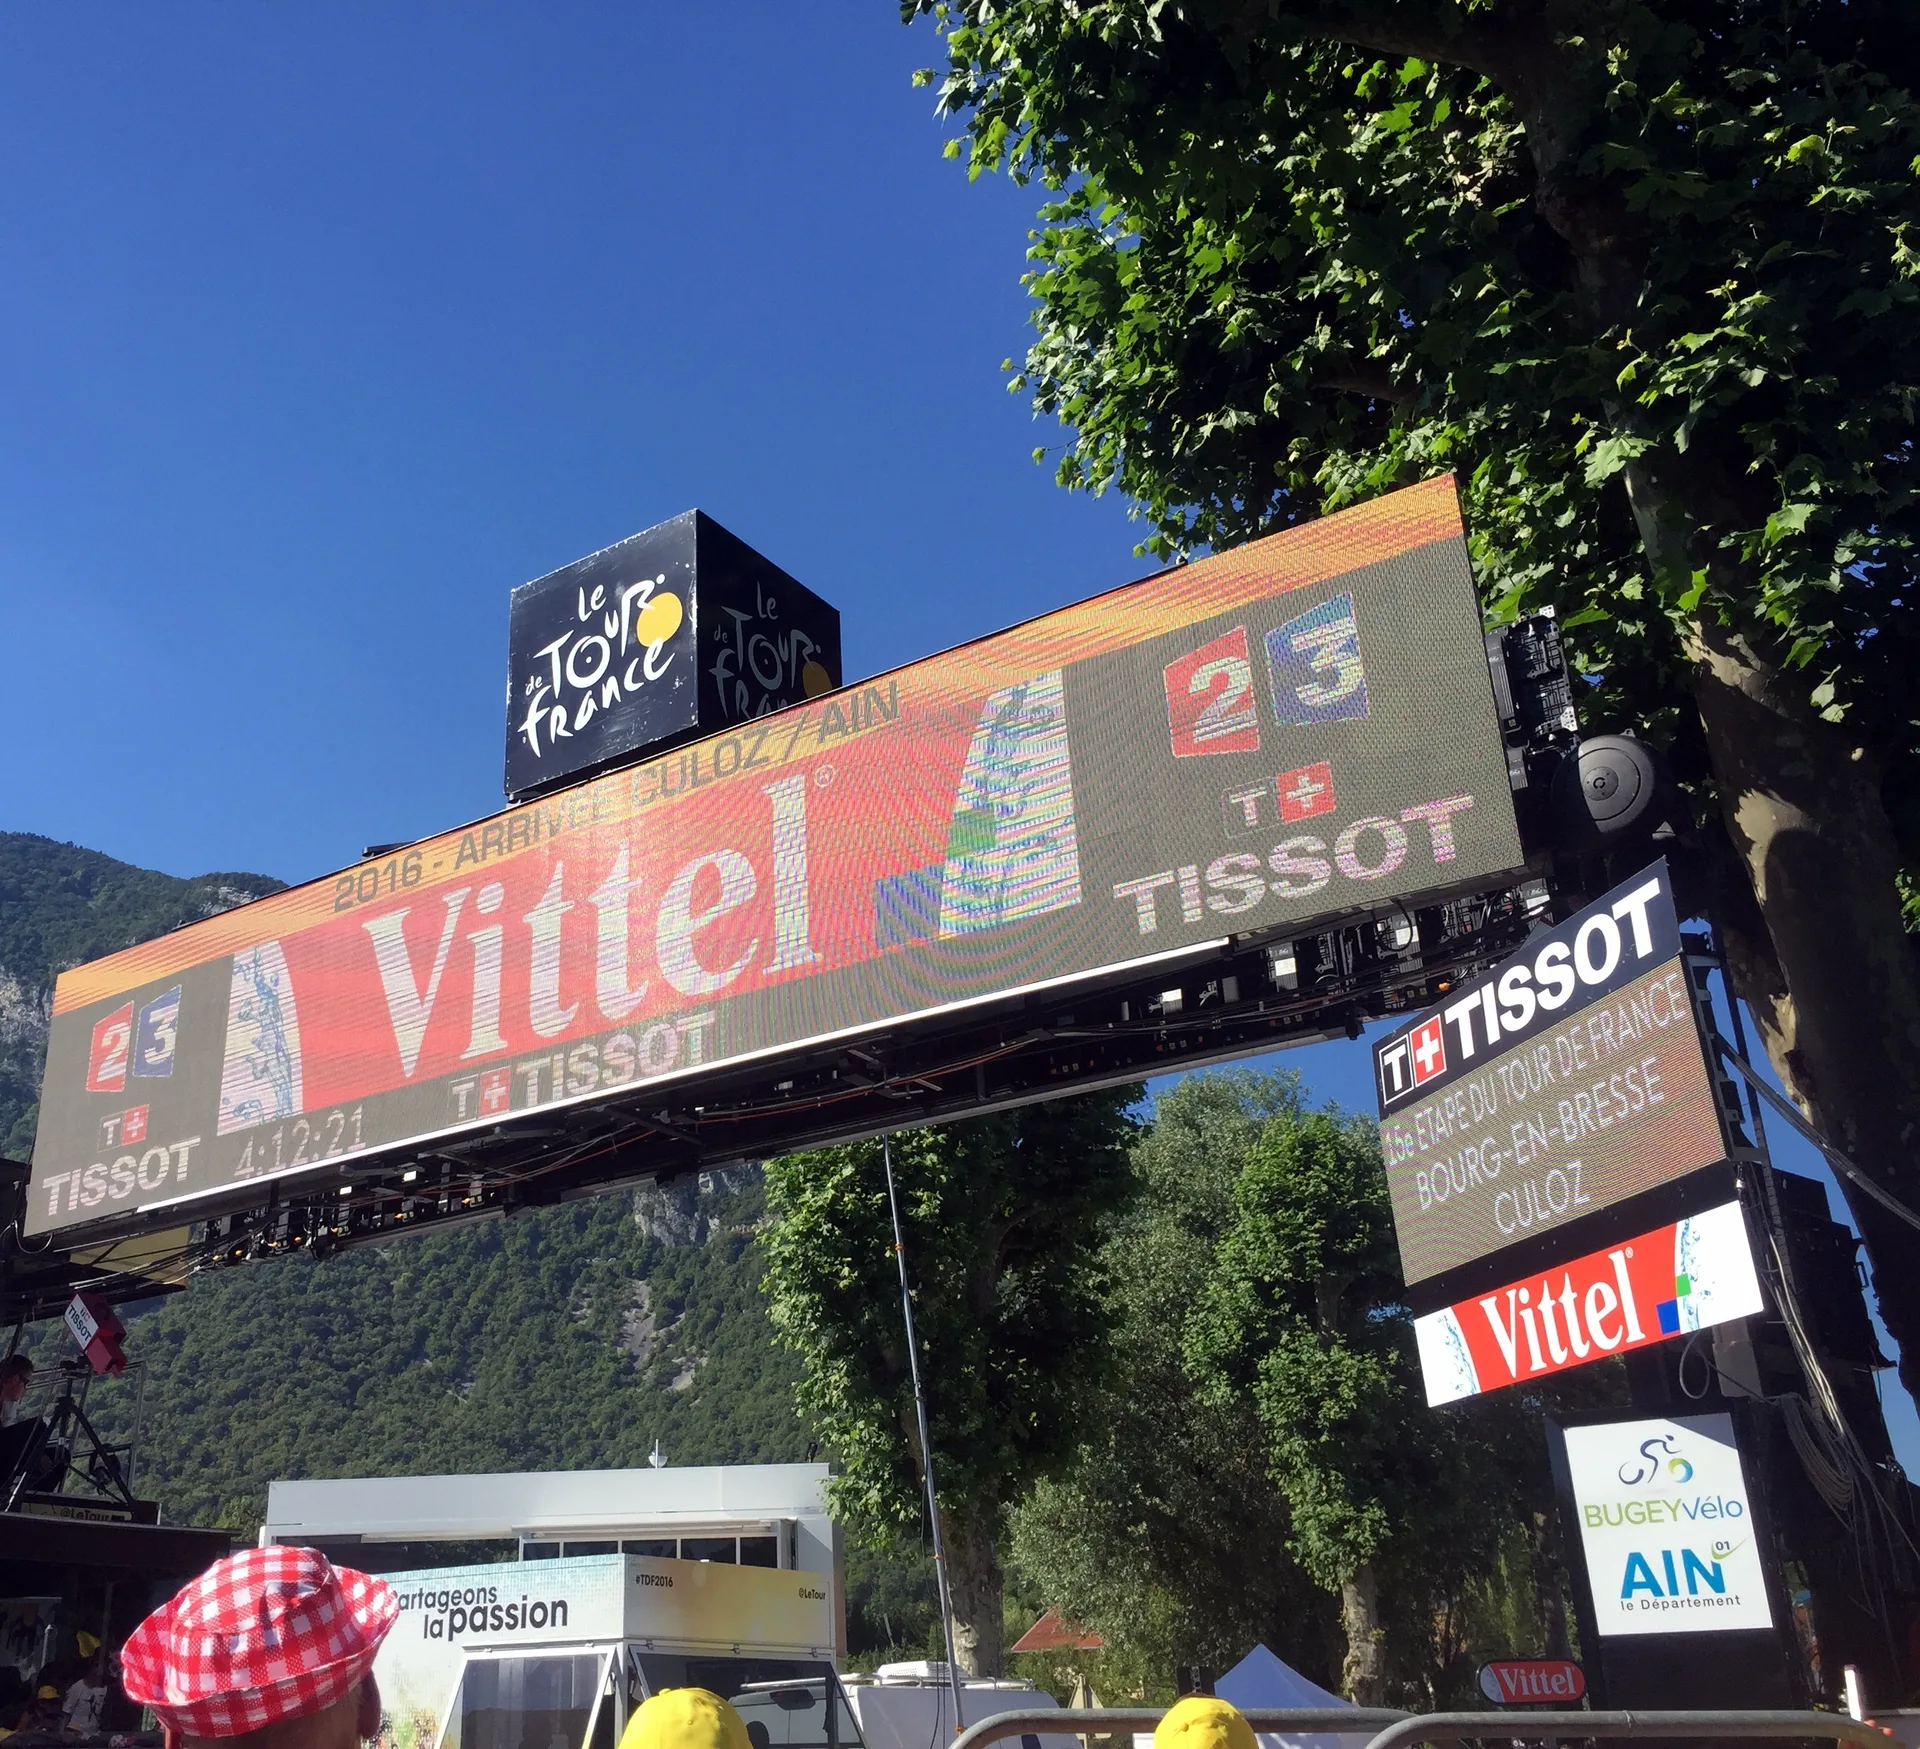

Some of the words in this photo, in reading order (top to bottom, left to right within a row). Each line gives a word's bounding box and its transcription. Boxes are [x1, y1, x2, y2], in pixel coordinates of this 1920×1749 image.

[714, 624, 728, 643] de
[525, 675, 543, 697] de
[1188, 656, 1257, 743] 2
[1292, 617, 1365, 706] 3
[334, 850, 423, 912] 2016
[632, 725, 770, 806] CULOZ
[817, 679, 900, 744] AIN
[1113, 791, 1474, 934] TISSOT
[361, 774, 822, 1078] Vittel
[1446, 878, 1660, 1058] TISSOT
[97, 1022, 129, 1082] 2
[144, 1003, 181, 1065] 3
[516, 1010, 715, 1107] TISSOT
[1415, 1091, 1469, 1150] ETAPE
[1469, 1076, 1497, 1122] DU
[1498, 1045, 1556, 1106] TOUR
[1556, 1026, 1589, 1078] DE
[1588, 973, 1687, 1060] FRANCE
[234, 1104, 366, 1179] 4:12:21
[1416, 1057, 1665, 1210] BOURG-EN-BRESSE
[42, 1136, 200, 1216] TISSOT
[1495, 1160, 1590, 1234] CULOZ
[69, 1304, 91, 1341] TISSOT
[1479, 1249, 1646, 1379] Vittel
[636, 1574, 673, 1587] #TDF2016
[1620, 1549, 1726, 1599] AIN
[1715, 1541, 1730, 1552] 01
[424, 1614, 443, 1639] la
[448, 1595, 568, 1642] passion
[798, 1587, 826, 1600] @LeTour
[1621, 1600, 1634, 1611] le
[1641, 1595, 1741, 1611] Département
[1499, 1666, 1576, 1696] Vittel
